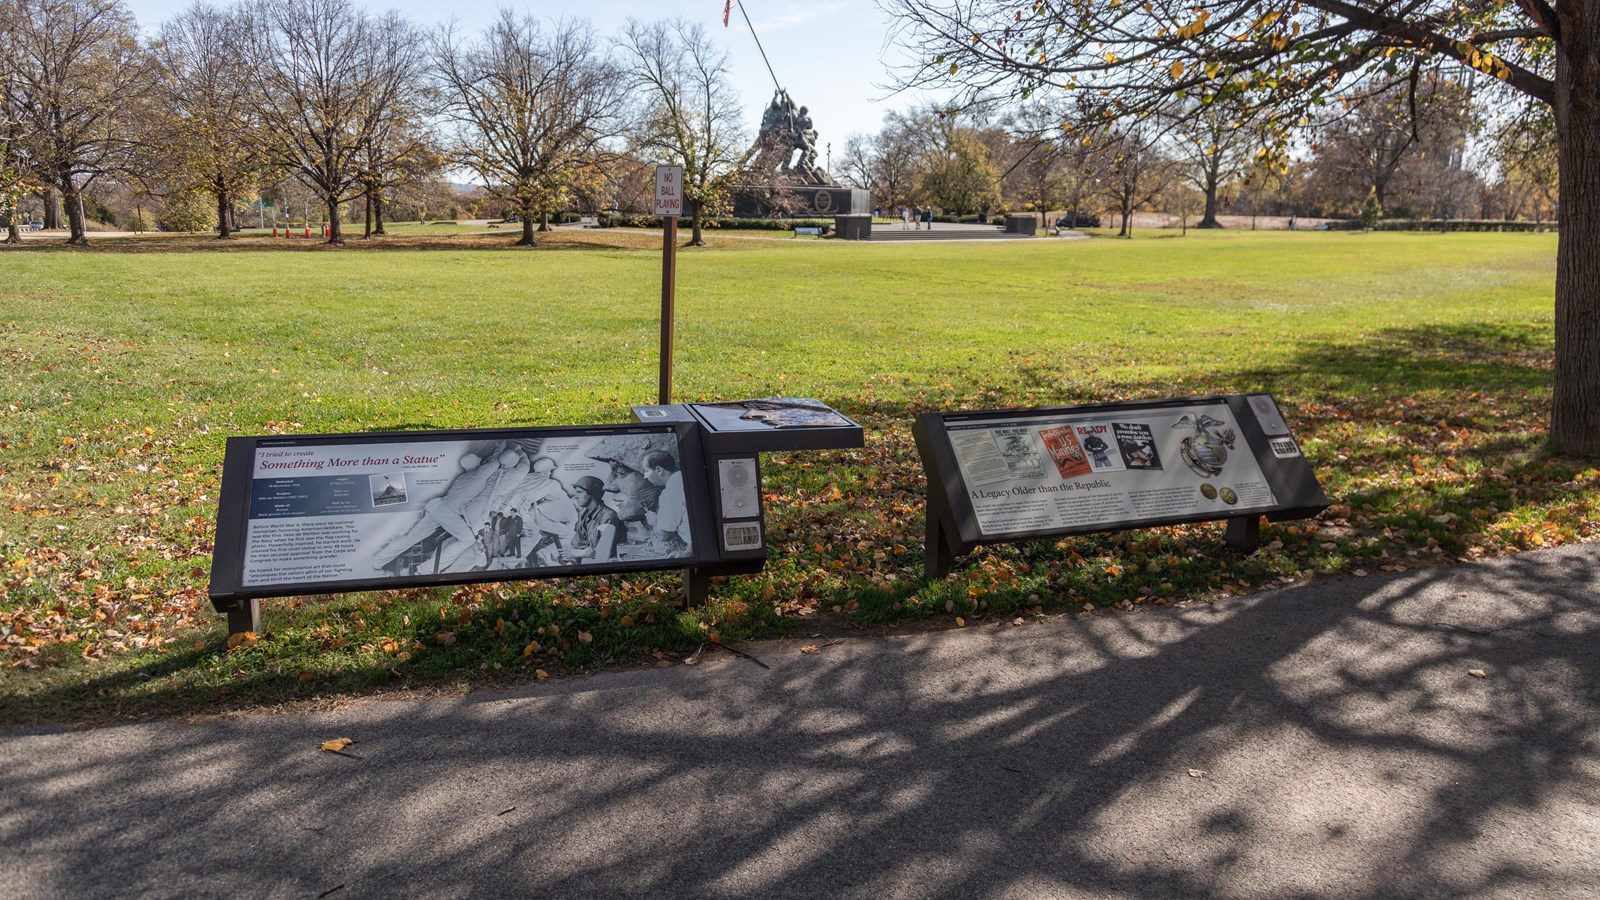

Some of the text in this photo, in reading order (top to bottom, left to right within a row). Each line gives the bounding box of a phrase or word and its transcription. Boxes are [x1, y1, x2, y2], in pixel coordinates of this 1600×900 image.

[664, 173, 673, 182] NO
[661, 186, 674, 195] BALL
[656, 199, 679, 208] PLAYING
[1076, 425, 1107, 435] READY
[1048, 444, 1080, 460] Marines
[260, 459, 324, 470] Something
[327, 458, 359, 467] More
[362, 457, 389, 466] than
[972, 480, 1111, 499] A Legacy Older than the Republic
